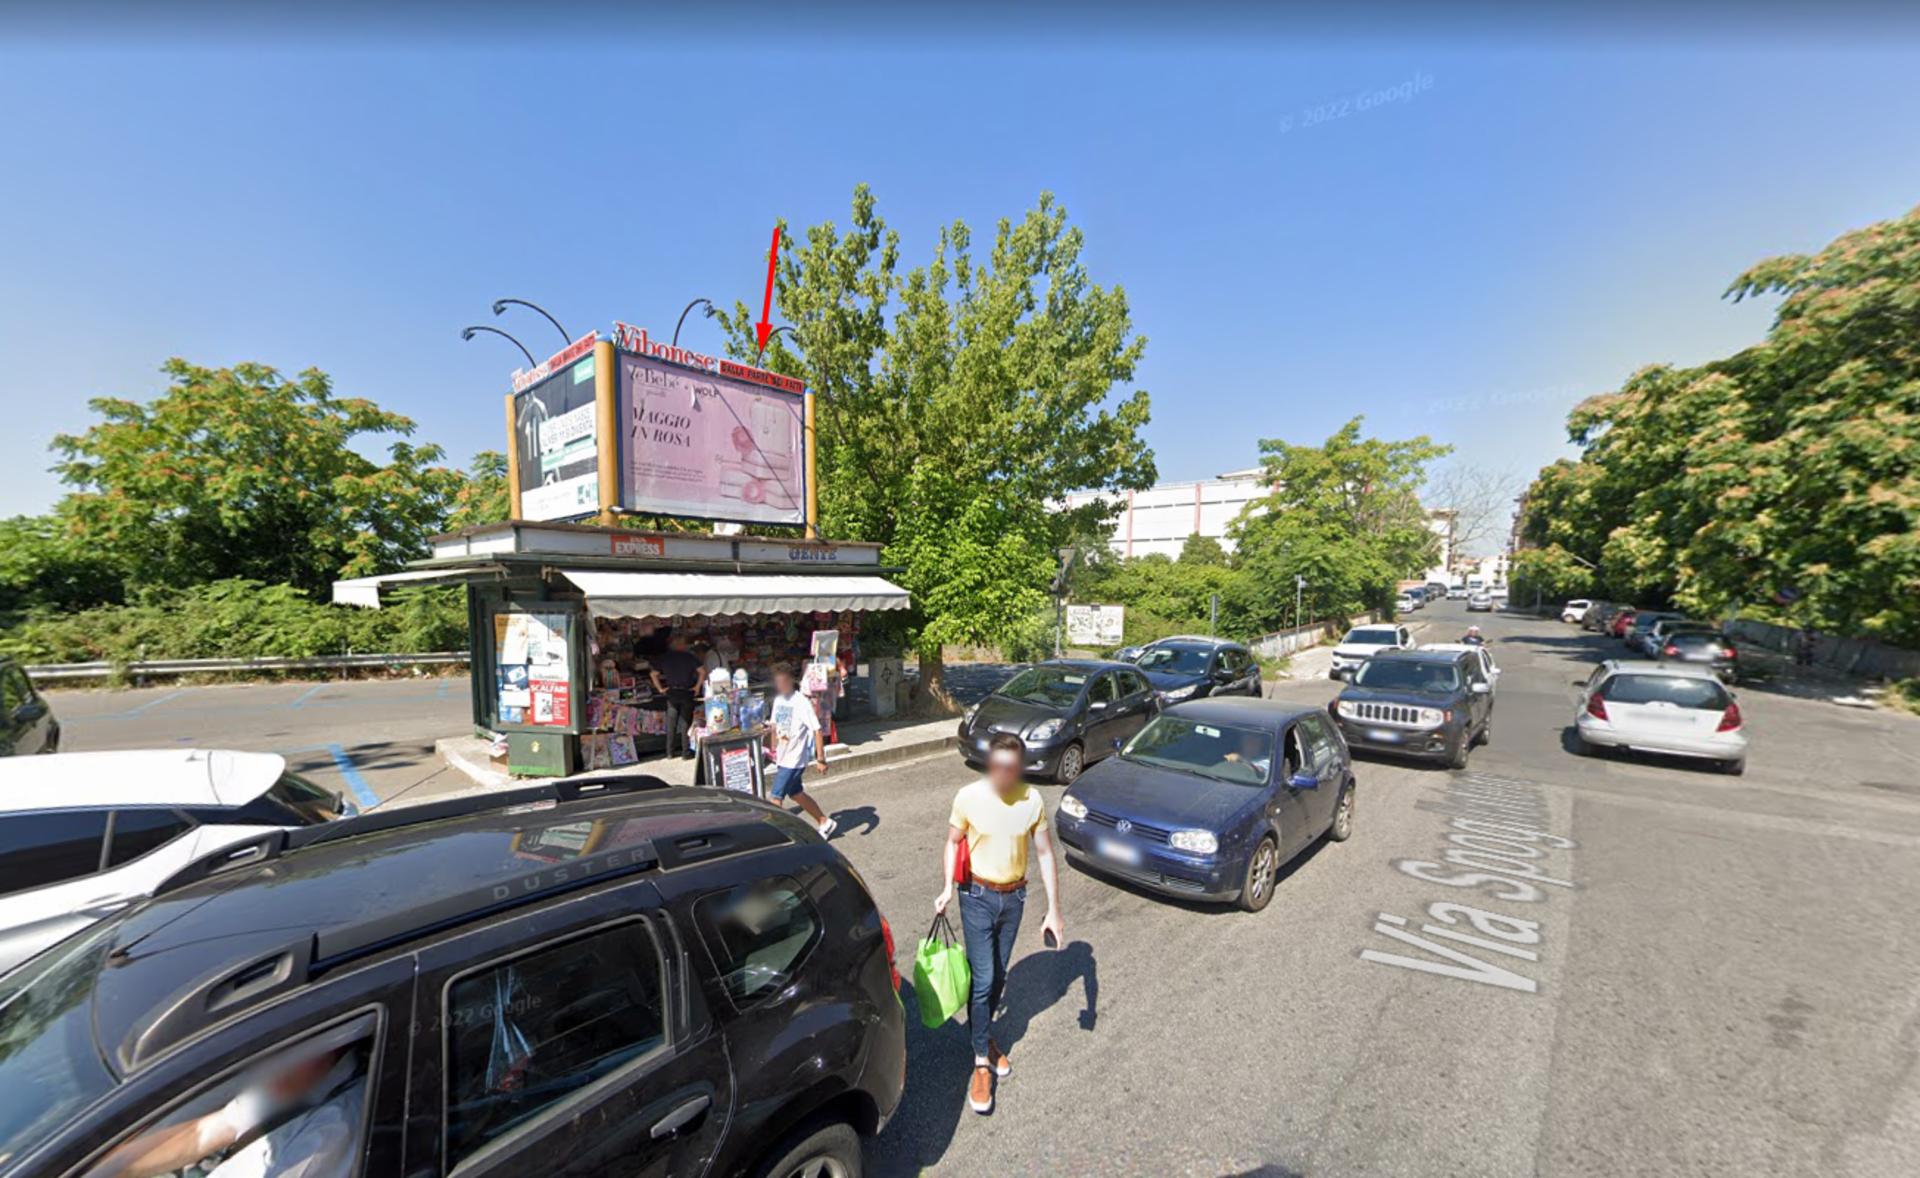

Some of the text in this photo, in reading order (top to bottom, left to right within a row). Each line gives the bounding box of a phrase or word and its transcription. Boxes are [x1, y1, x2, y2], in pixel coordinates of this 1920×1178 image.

[615, 321, 716, 369] Vibonese
[632, 407, 691, 430] MAGGIO
[653, 429, 692, 449] ROSA
[493, 849, 645, 900] DUSTER
[1360, 902, 1541, 993] Via
